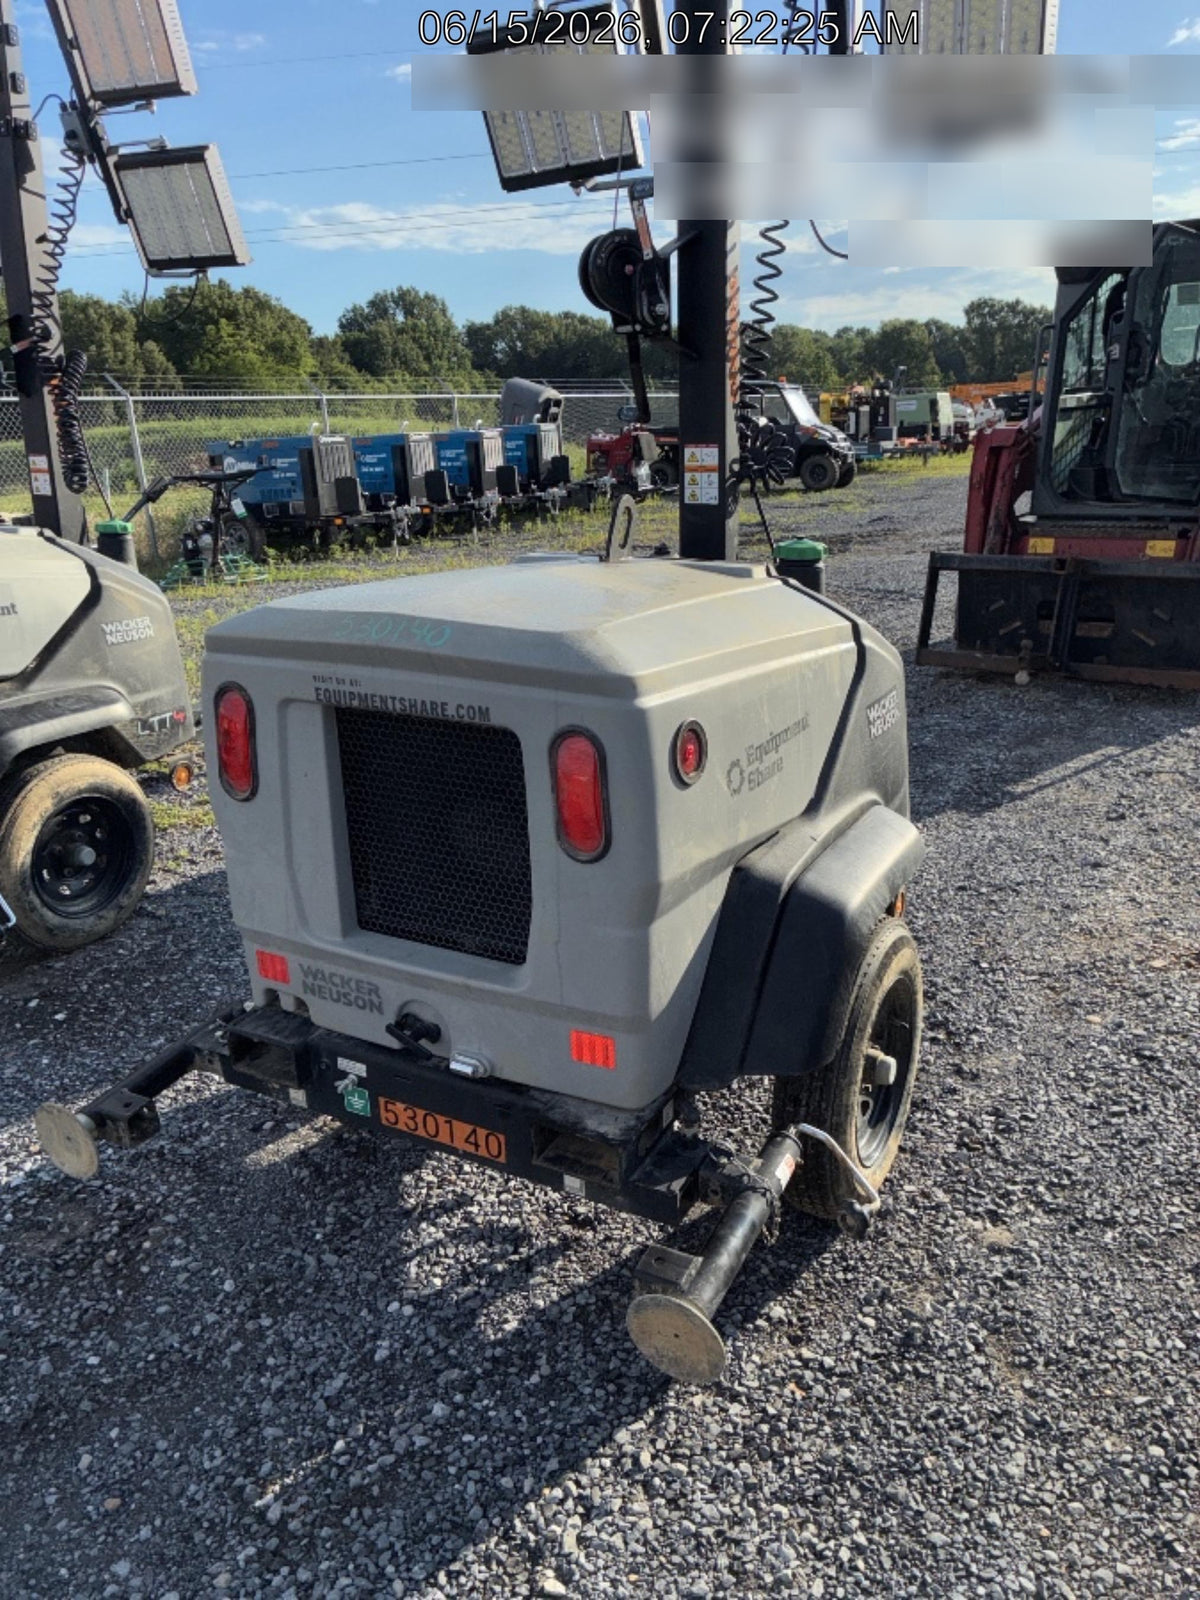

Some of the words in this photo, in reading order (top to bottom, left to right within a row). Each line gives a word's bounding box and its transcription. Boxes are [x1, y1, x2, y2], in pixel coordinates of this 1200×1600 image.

[101, 616, 152, 634] WACKER
[106, 630, 154, 645] NEUSON
[314, 686, 492, 723] EQUIPMENTSHARE.COM
[747, 757, 784, 792] Share
[299, 962, 383, 999] WACKER
[302, 978, 385, 1016] NEUSON
[382, 1100, 504, 1160] 530140
